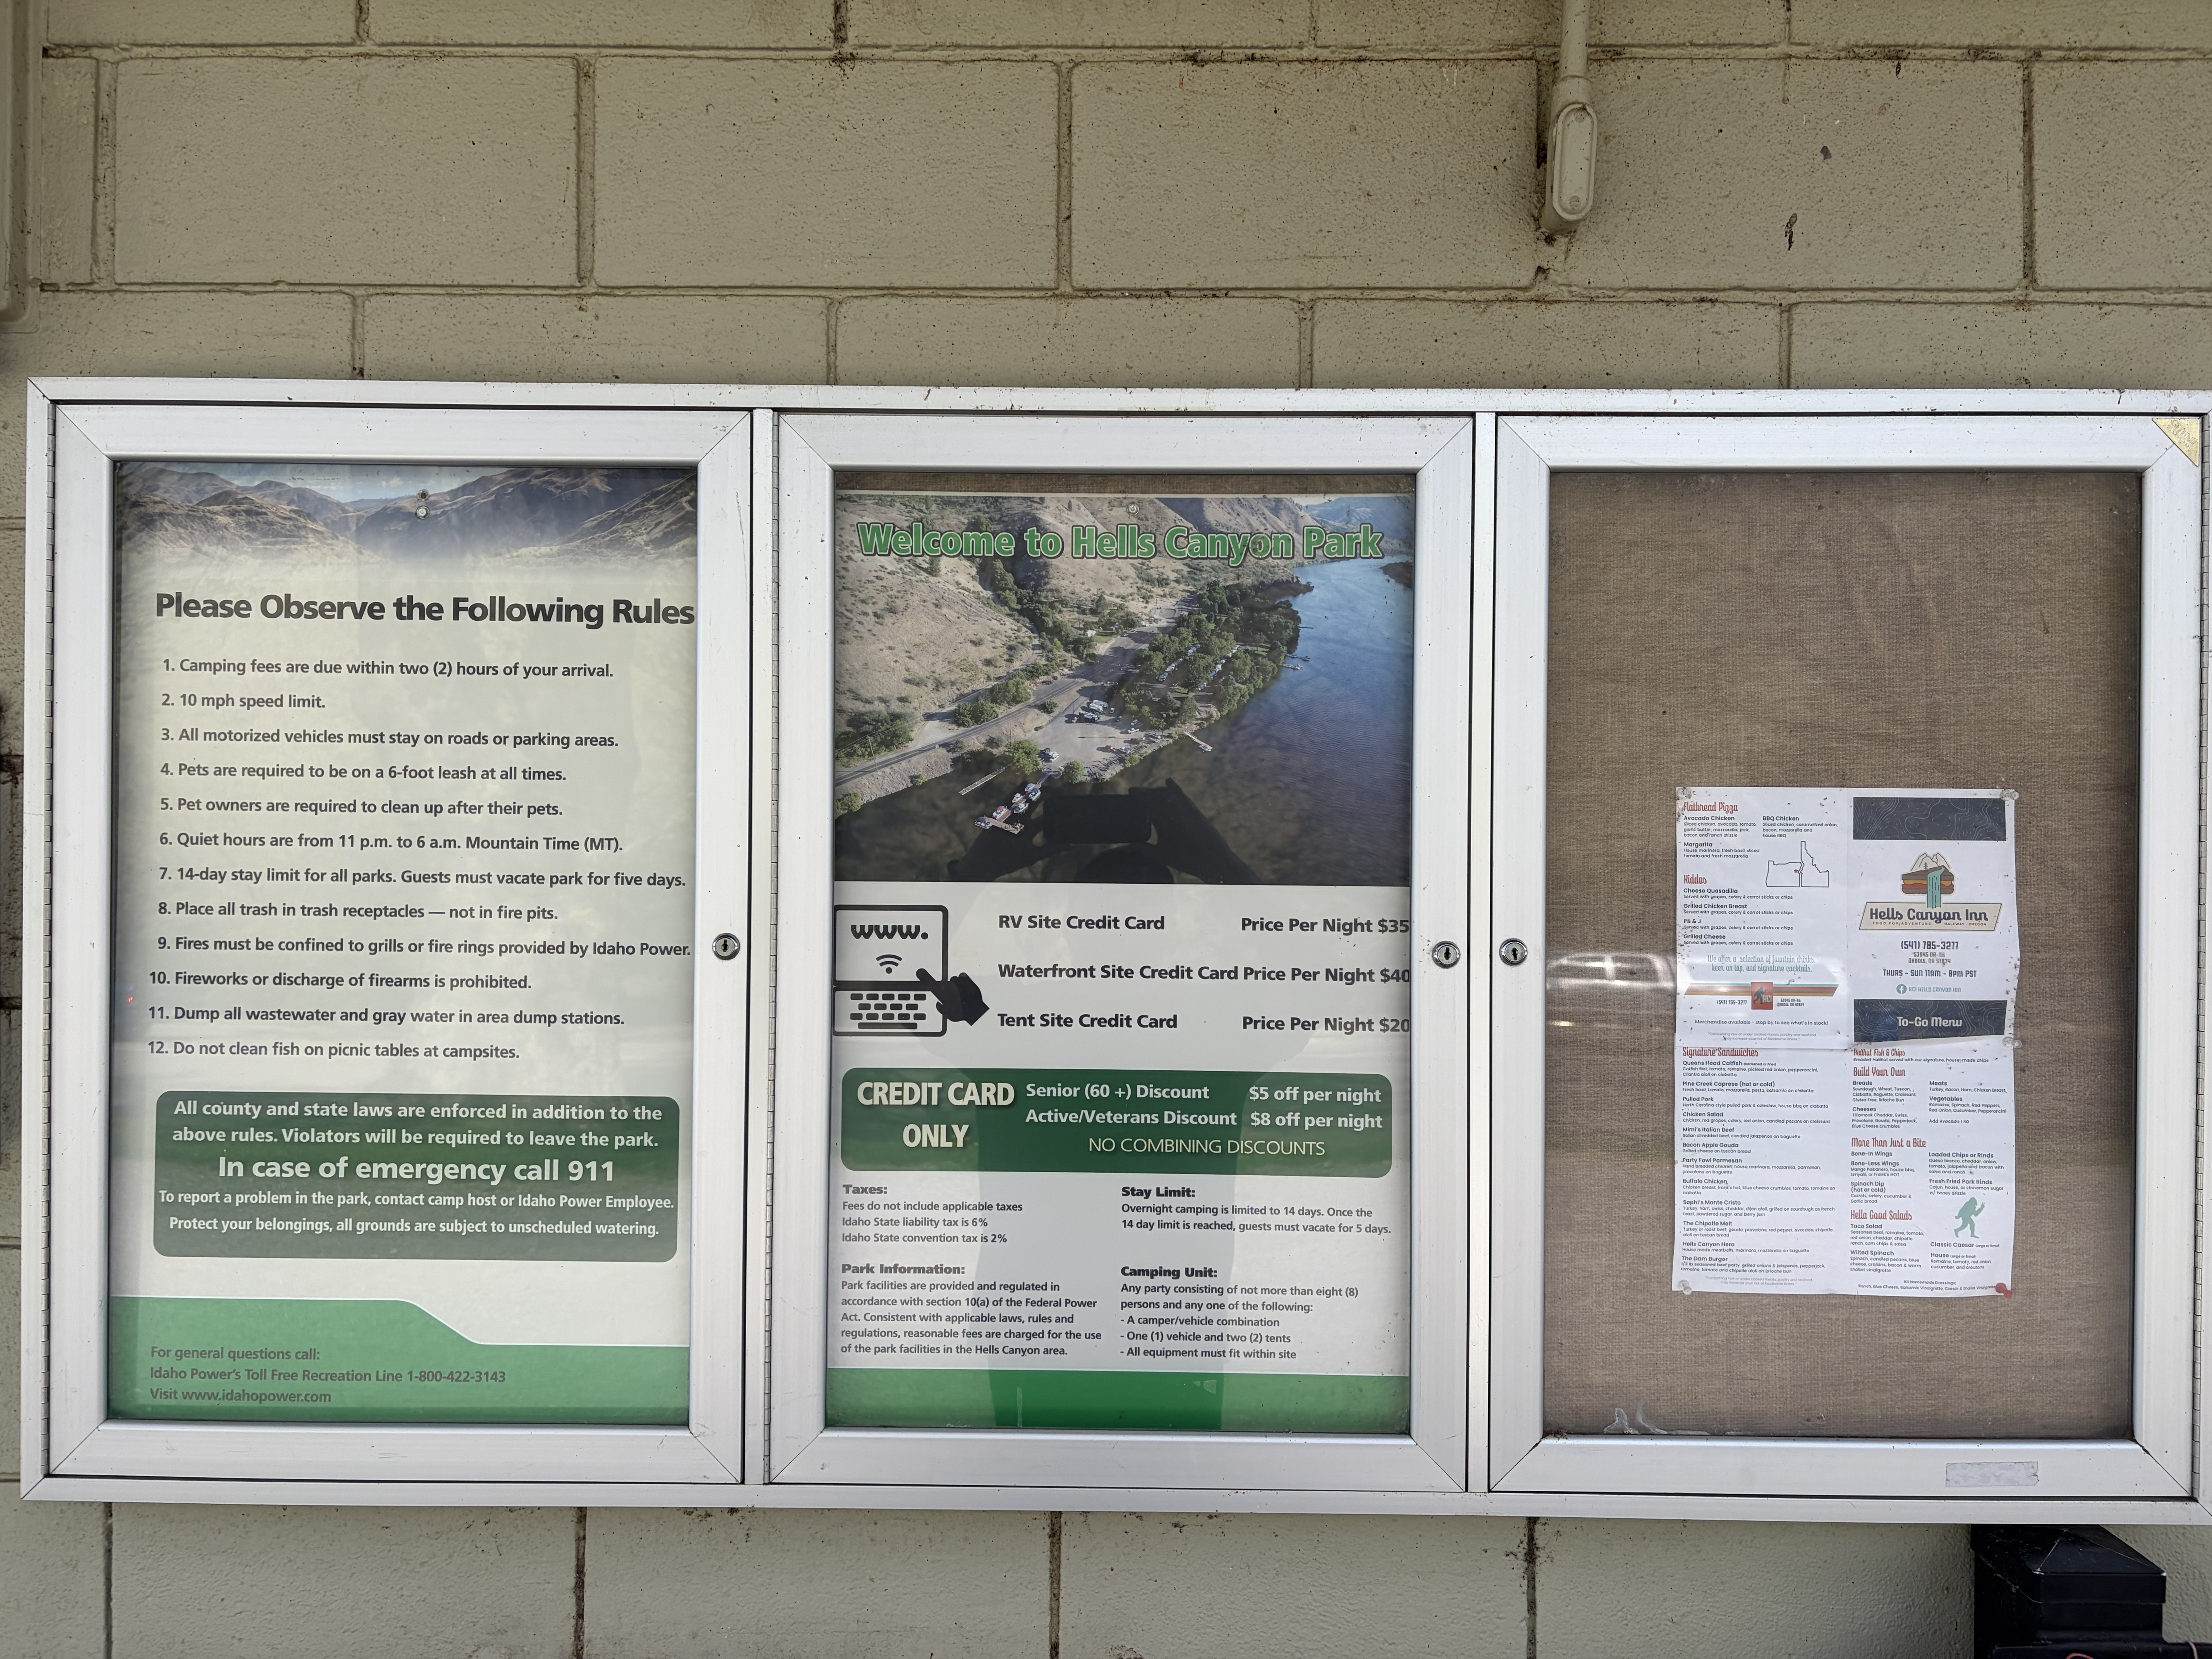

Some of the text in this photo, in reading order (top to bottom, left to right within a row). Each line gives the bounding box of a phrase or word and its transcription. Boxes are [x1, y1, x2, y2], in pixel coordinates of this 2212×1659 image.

[858, 522, 1380, 565] Welcome to Hells Canyon Park
[156, 592, 695, 630] Please Observe the Following Rules
[163, 659, 613, 679] 1. Camping fees are due within two (2) hours of your arrival.
[161, 693, 325, 711] 2. 10 mph speed limit.
[1719, 802, 1738, 814] Pizza
[1684, 874, 1707, 884] Kiddos
[1870, 907, 1989, 924] Hells Canyon Inn
[851, 924, 929, 940] www.
[999, 915, 1410, 936] RV Site Credit Card Price Per Night $35
[1901, 941, 1959, 950] (541) 785-3277
[997, 1013, 1410, 1035] Tent Site Credit Card Price Per Night $20
[1896, 1016, 1962, 1027] To-Go Menu
[1682, 1047, 1759, 1058] Signature Sandwiches
[1853, 1066, 1906, 1077] Build Your Own
[857, 1082, 1015, 1106] CREDIT CARD
[1026, 1083, 1382, 1106] Senior (60 +) Discount $5 off per night
[903, 1124, 969, 1147] ONLY
[1851, 1137, 1870, 1147] More
[1872, 1137, 1887, 1147] Than
[1889, 1137, 1904, 1147] Just
[1913, 1137, 1926, 1148] Bite
[1089, 1138, 1325, 1155] NO COMBINING DISCOUNTS
[219, 1156, 613, 1186] In case of emergency call 911
[842, 1184, 888, 1194] Taxes:
[1121, 1186, 1195, 1199] Stay Limit:
[842, 1216, 988, 1229] Idaho State liability tax is 6%
[1851, 1209, 1912, 1221] Hella Good Salads
[842, 1263, 965, 1274] Park Information:
[1121, 1266, 1218, 1280] Camping Unit:
[151, 1346, 320, 1362] For general questions call:
[1127, 1346, 1140, 1356] All
[1143, 1347, 1198, 1359] equipment
[1201, 1349, 1226, 1358] must
[1228, 1348, 1241, 1358] fit
[1243, 1349, 1276, 1358] within
[1278, 1349, 1297, 1359] site
[150, 1366, 506, 1383] Idaho Power's Toll Free Recreation Line 1-800-422-3143
[150, 1388, 331, 1405] Visit www.idahopower.com
